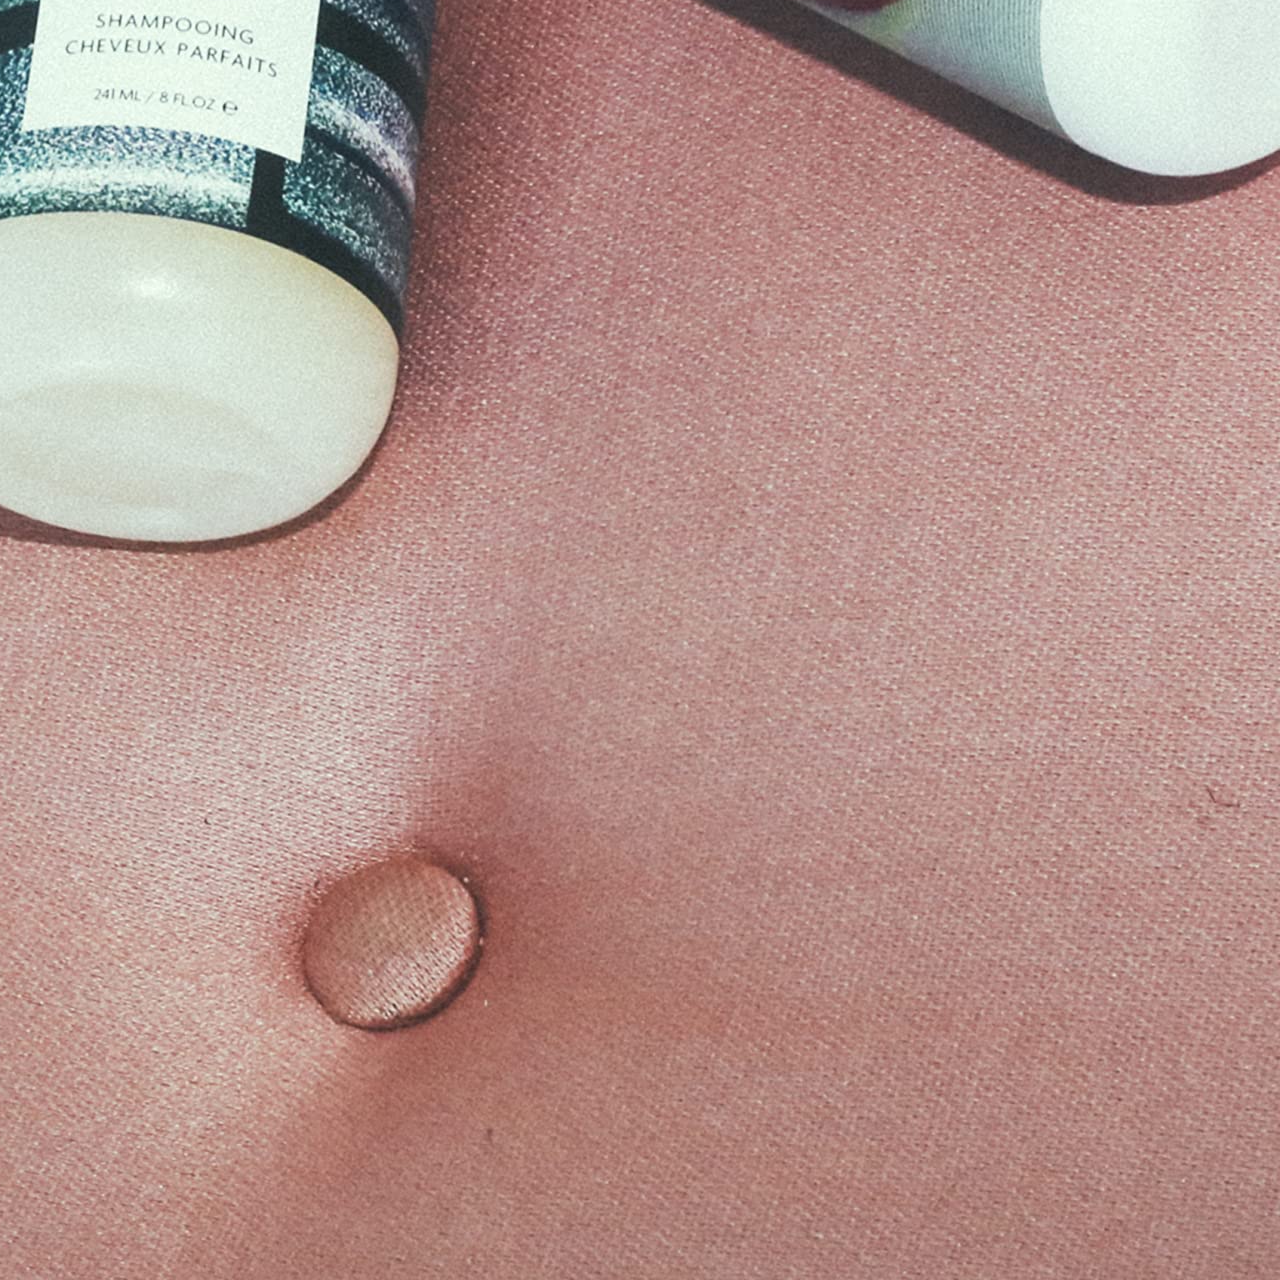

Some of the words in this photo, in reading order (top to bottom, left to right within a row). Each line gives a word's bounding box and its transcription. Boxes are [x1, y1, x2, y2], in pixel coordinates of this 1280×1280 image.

[95, 12, 255, 45] SHAMPOOING
[65, 38, 166, 56] CHEVEUX
[176, 41, 279, 79] PARFAITS
[93, 87, 116, 101] 241
[119, 88, 142, 102] ML
[158, 91, 170, 104] 8
